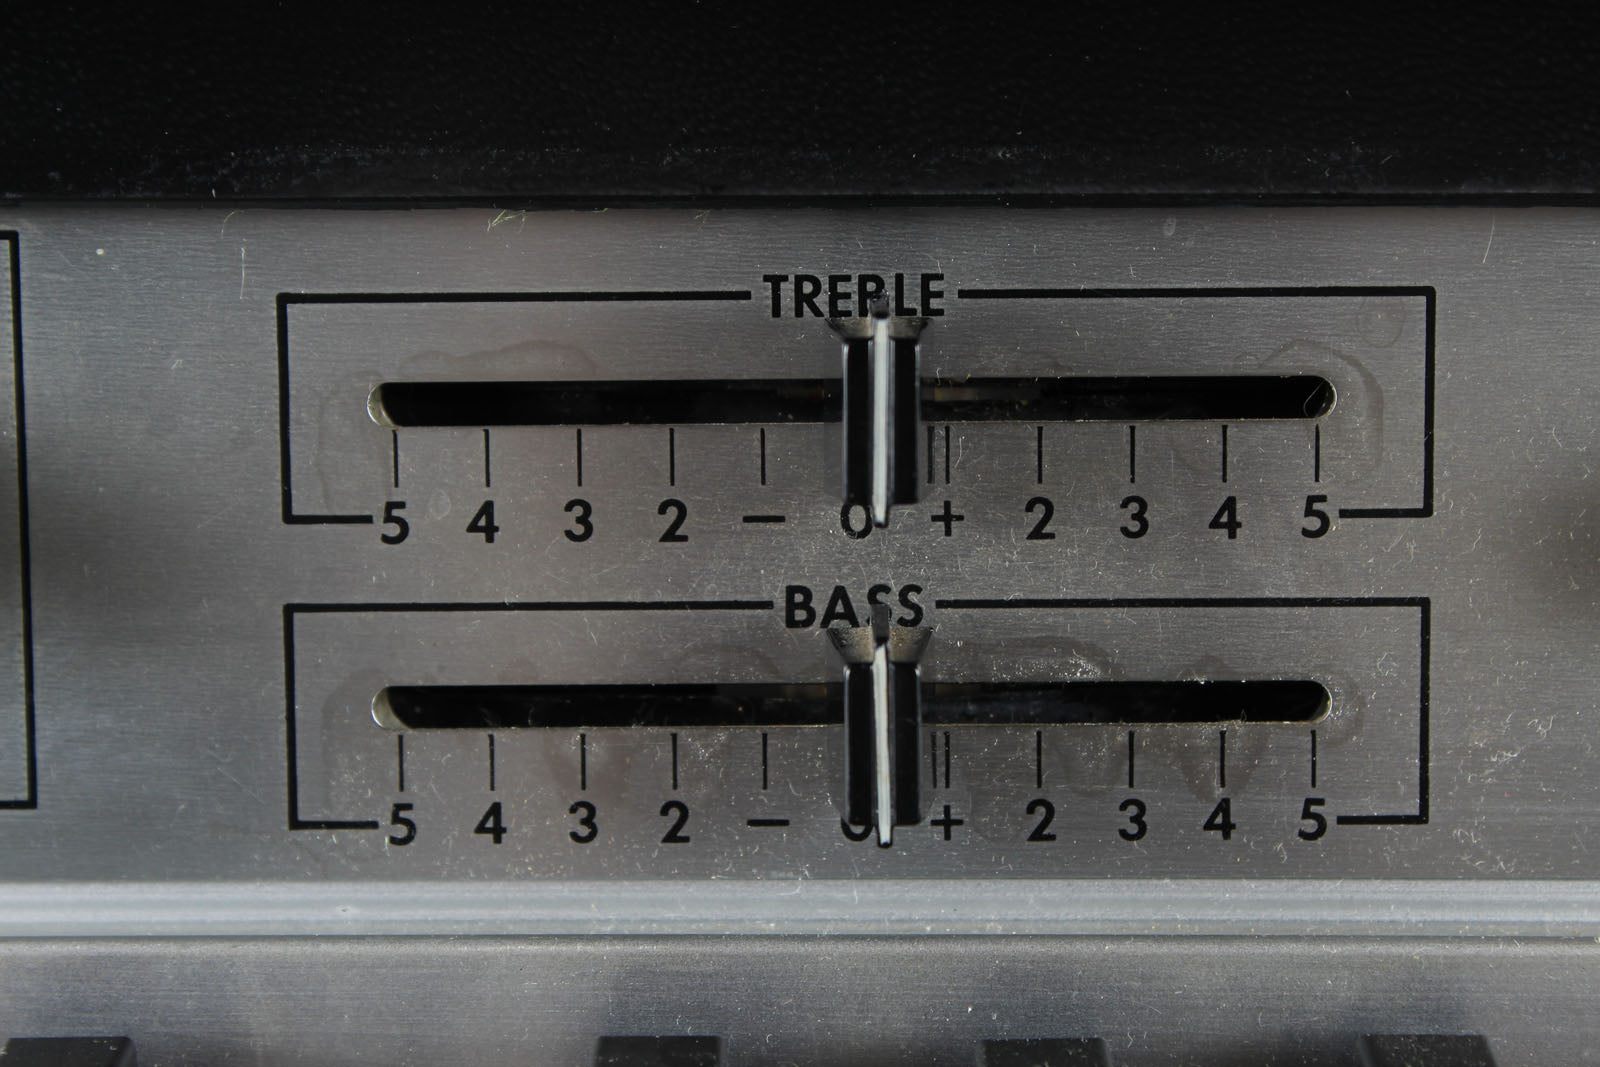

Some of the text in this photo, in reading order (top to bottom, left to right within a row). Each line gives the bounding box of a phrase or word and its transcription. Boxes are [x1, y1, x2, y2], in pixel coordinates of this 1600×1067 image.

[380, 500, 409, 544] 5
[465, 500, 499, 543] 4
[564, 499, 593, 542] 3
[658, 499, 689, 542] 2
[1025, 497, 1056, 540] 2
[1120, 496, 1149, 539] 3
[1209, 496, 1242, 539] 4
[1301, 495, 1331, 538] 5
[389, 803, 416, 846] 5
[474, 802, 507, 845] 4
[569, 801, 598, 844] 3
[660, 801, 691, 844] 2
[1026, 799, 1057, 842] 2
[1119, 799, 1148, 842] 3
[1203, 798, 1237, 841] 4
[1298, 798, 1327, 841] 5
